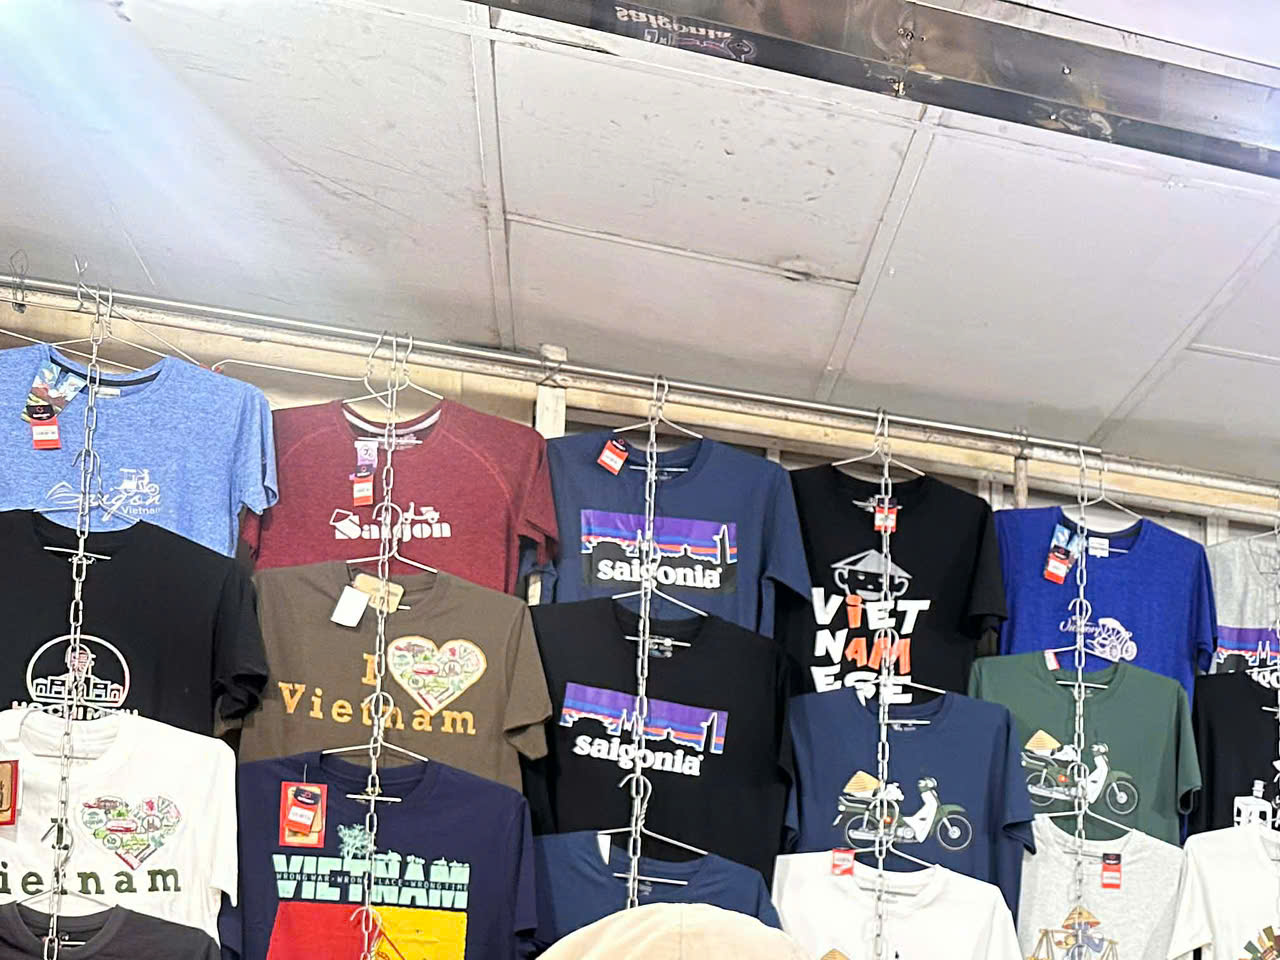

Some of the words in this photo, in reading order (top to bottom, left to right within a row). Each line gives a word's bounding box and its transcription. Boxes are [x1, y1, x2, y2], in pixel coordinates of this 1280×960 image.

[277, 680, 477, 736] Vietnam
[572, 733, 705, 777] saigonia
[0, 860, 182, 896] ietnam
[272, 853, 470, 910] VIETNAM
